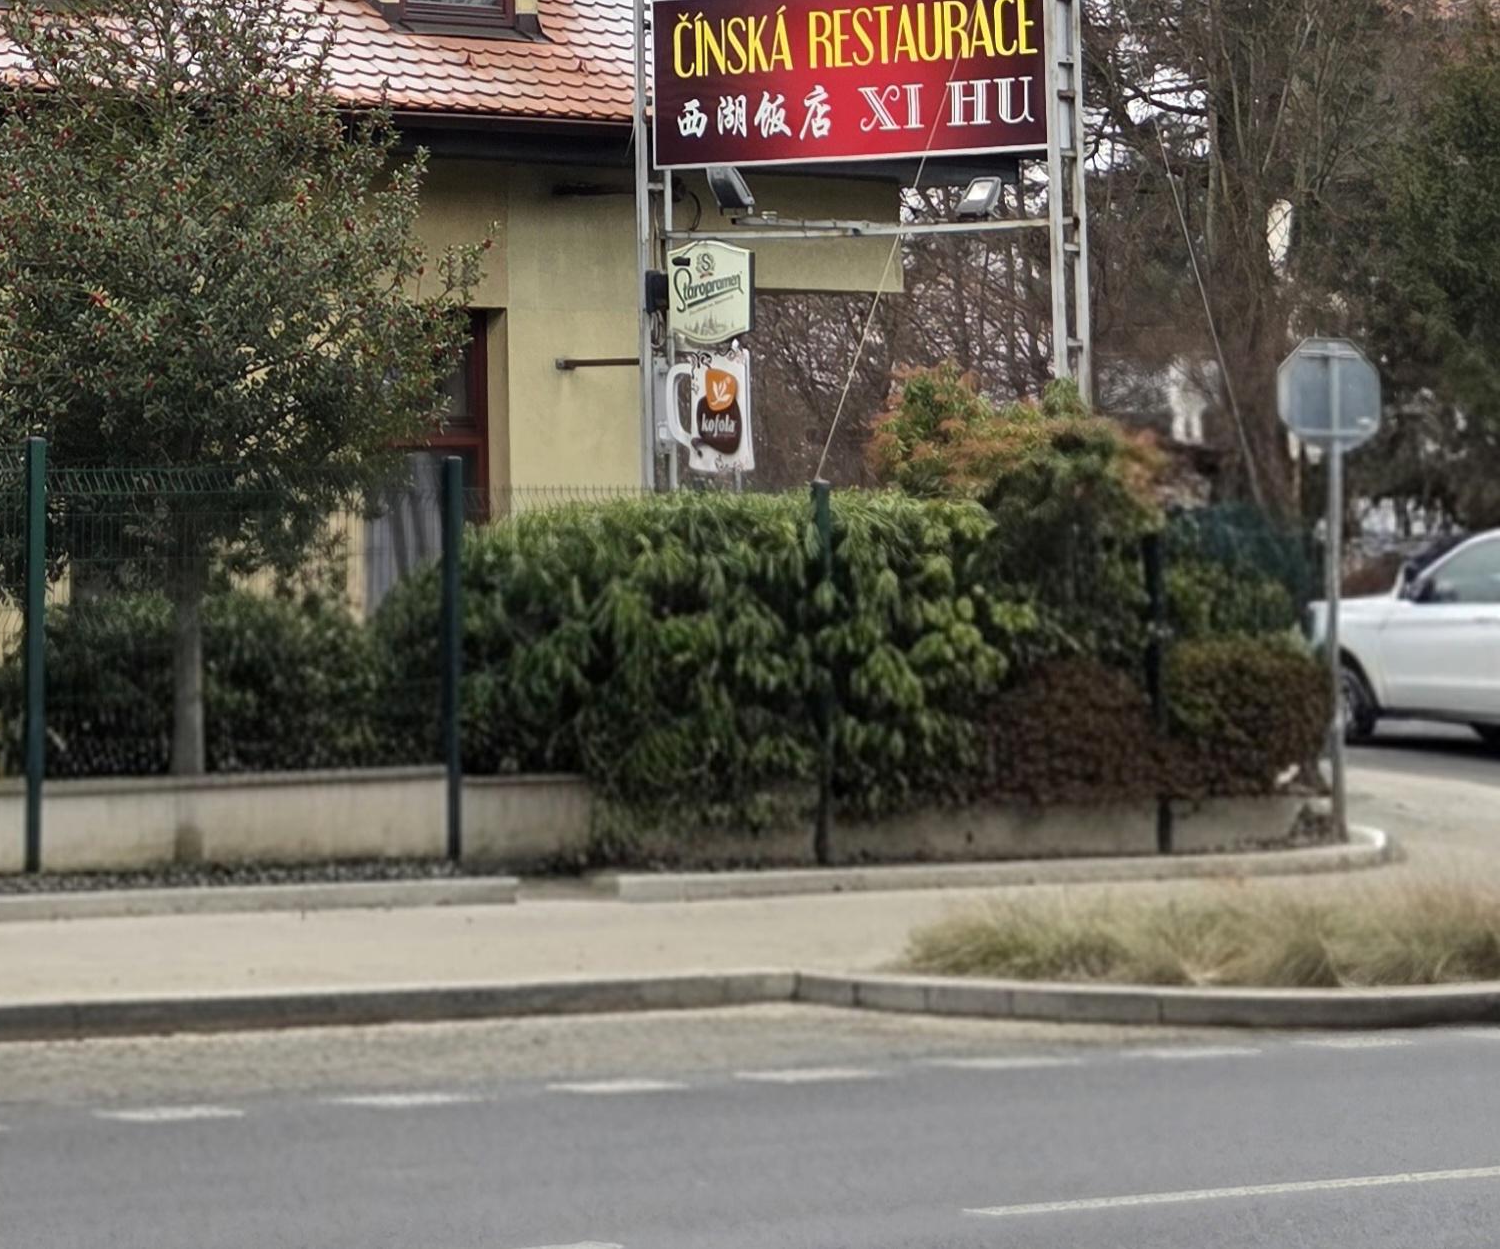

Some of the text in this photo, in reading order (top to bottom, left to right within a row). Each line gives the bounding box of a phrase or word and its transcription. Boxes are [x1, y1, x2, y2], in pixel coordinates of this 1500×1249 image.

[673, 5, 793, 78] ČÍNSKÁ
[857, 76, 1035, 132] XI HU
[673, 267, 744, 313] Staropramen
[701, 413, 737, 437] kofola
